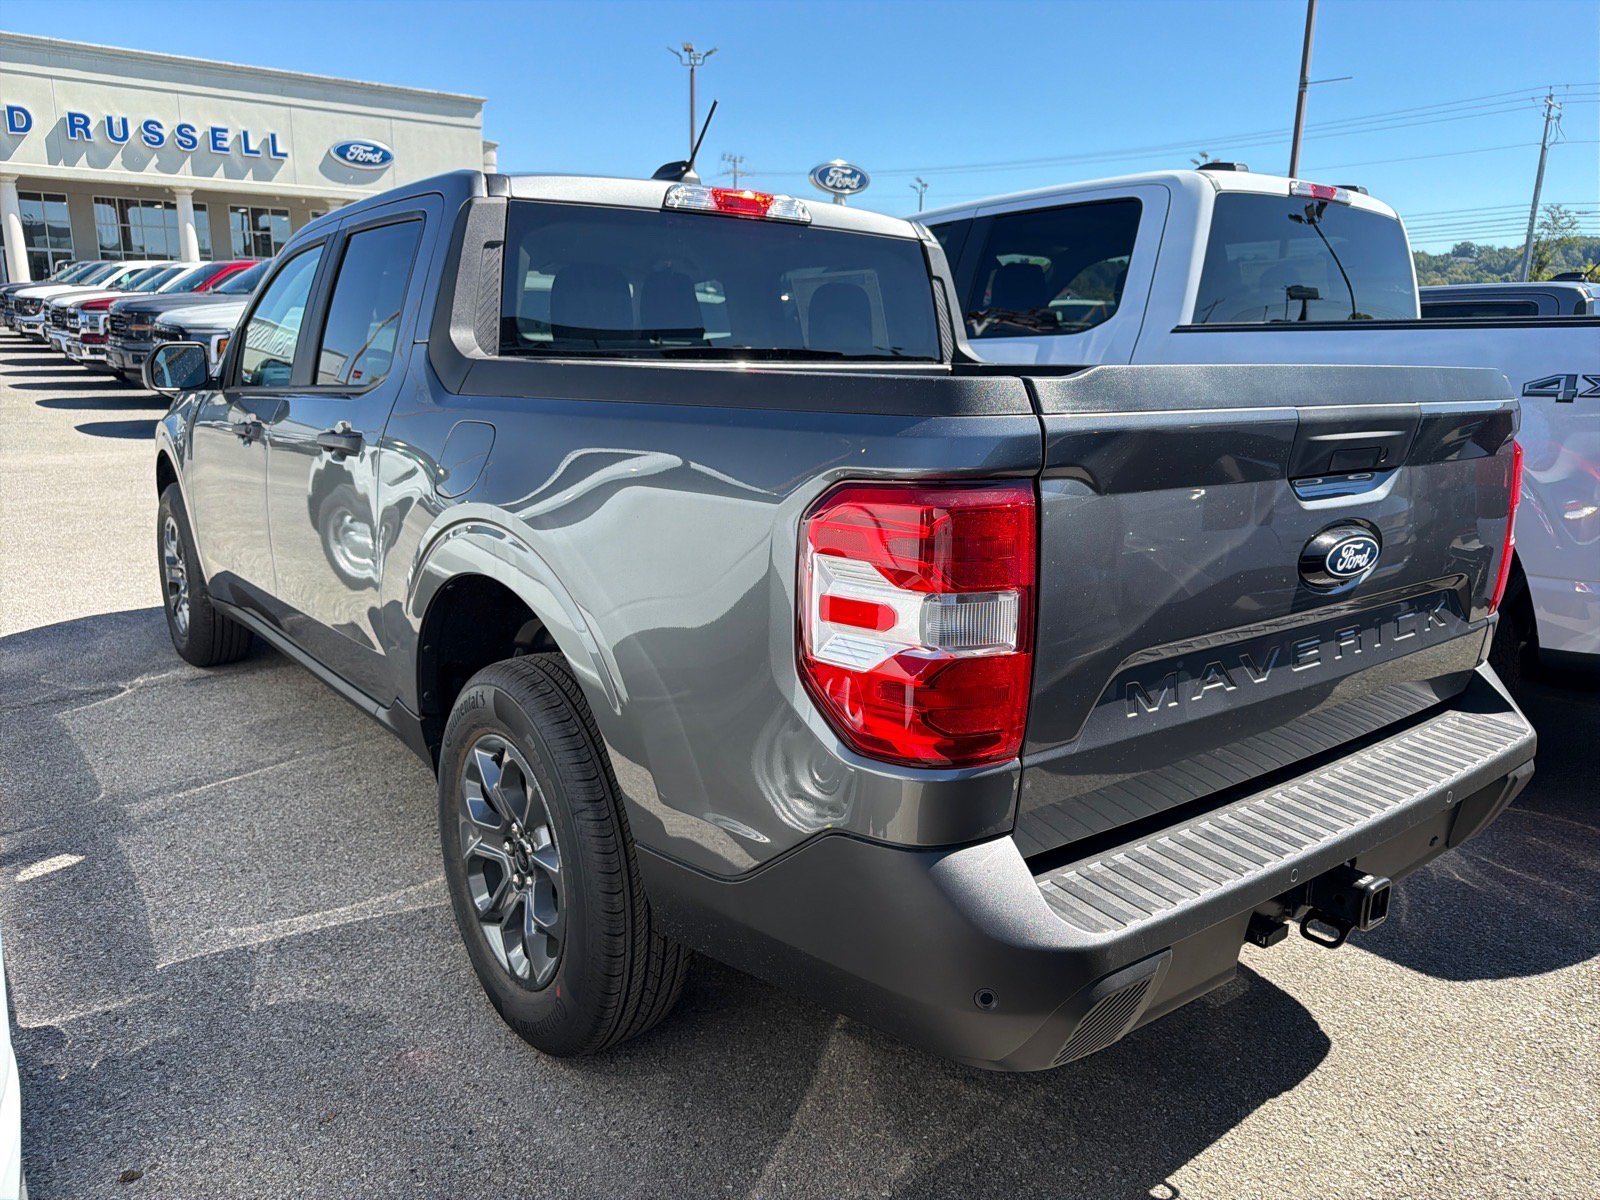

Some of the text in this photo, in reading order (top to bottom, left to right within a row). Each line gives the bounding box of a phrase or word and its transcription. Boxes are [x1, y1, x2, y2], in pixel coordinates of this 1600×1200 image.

[5, 104, 289, 160] D RUSSELL
[345, 144, 383, 163] Ford
[825, 167, 861, 189] Ford
[1336, 543, 1371, 571] Ford
[1125, 599, 1447, 718] MAVERICK
[445, 690, 480, 748] Continental
